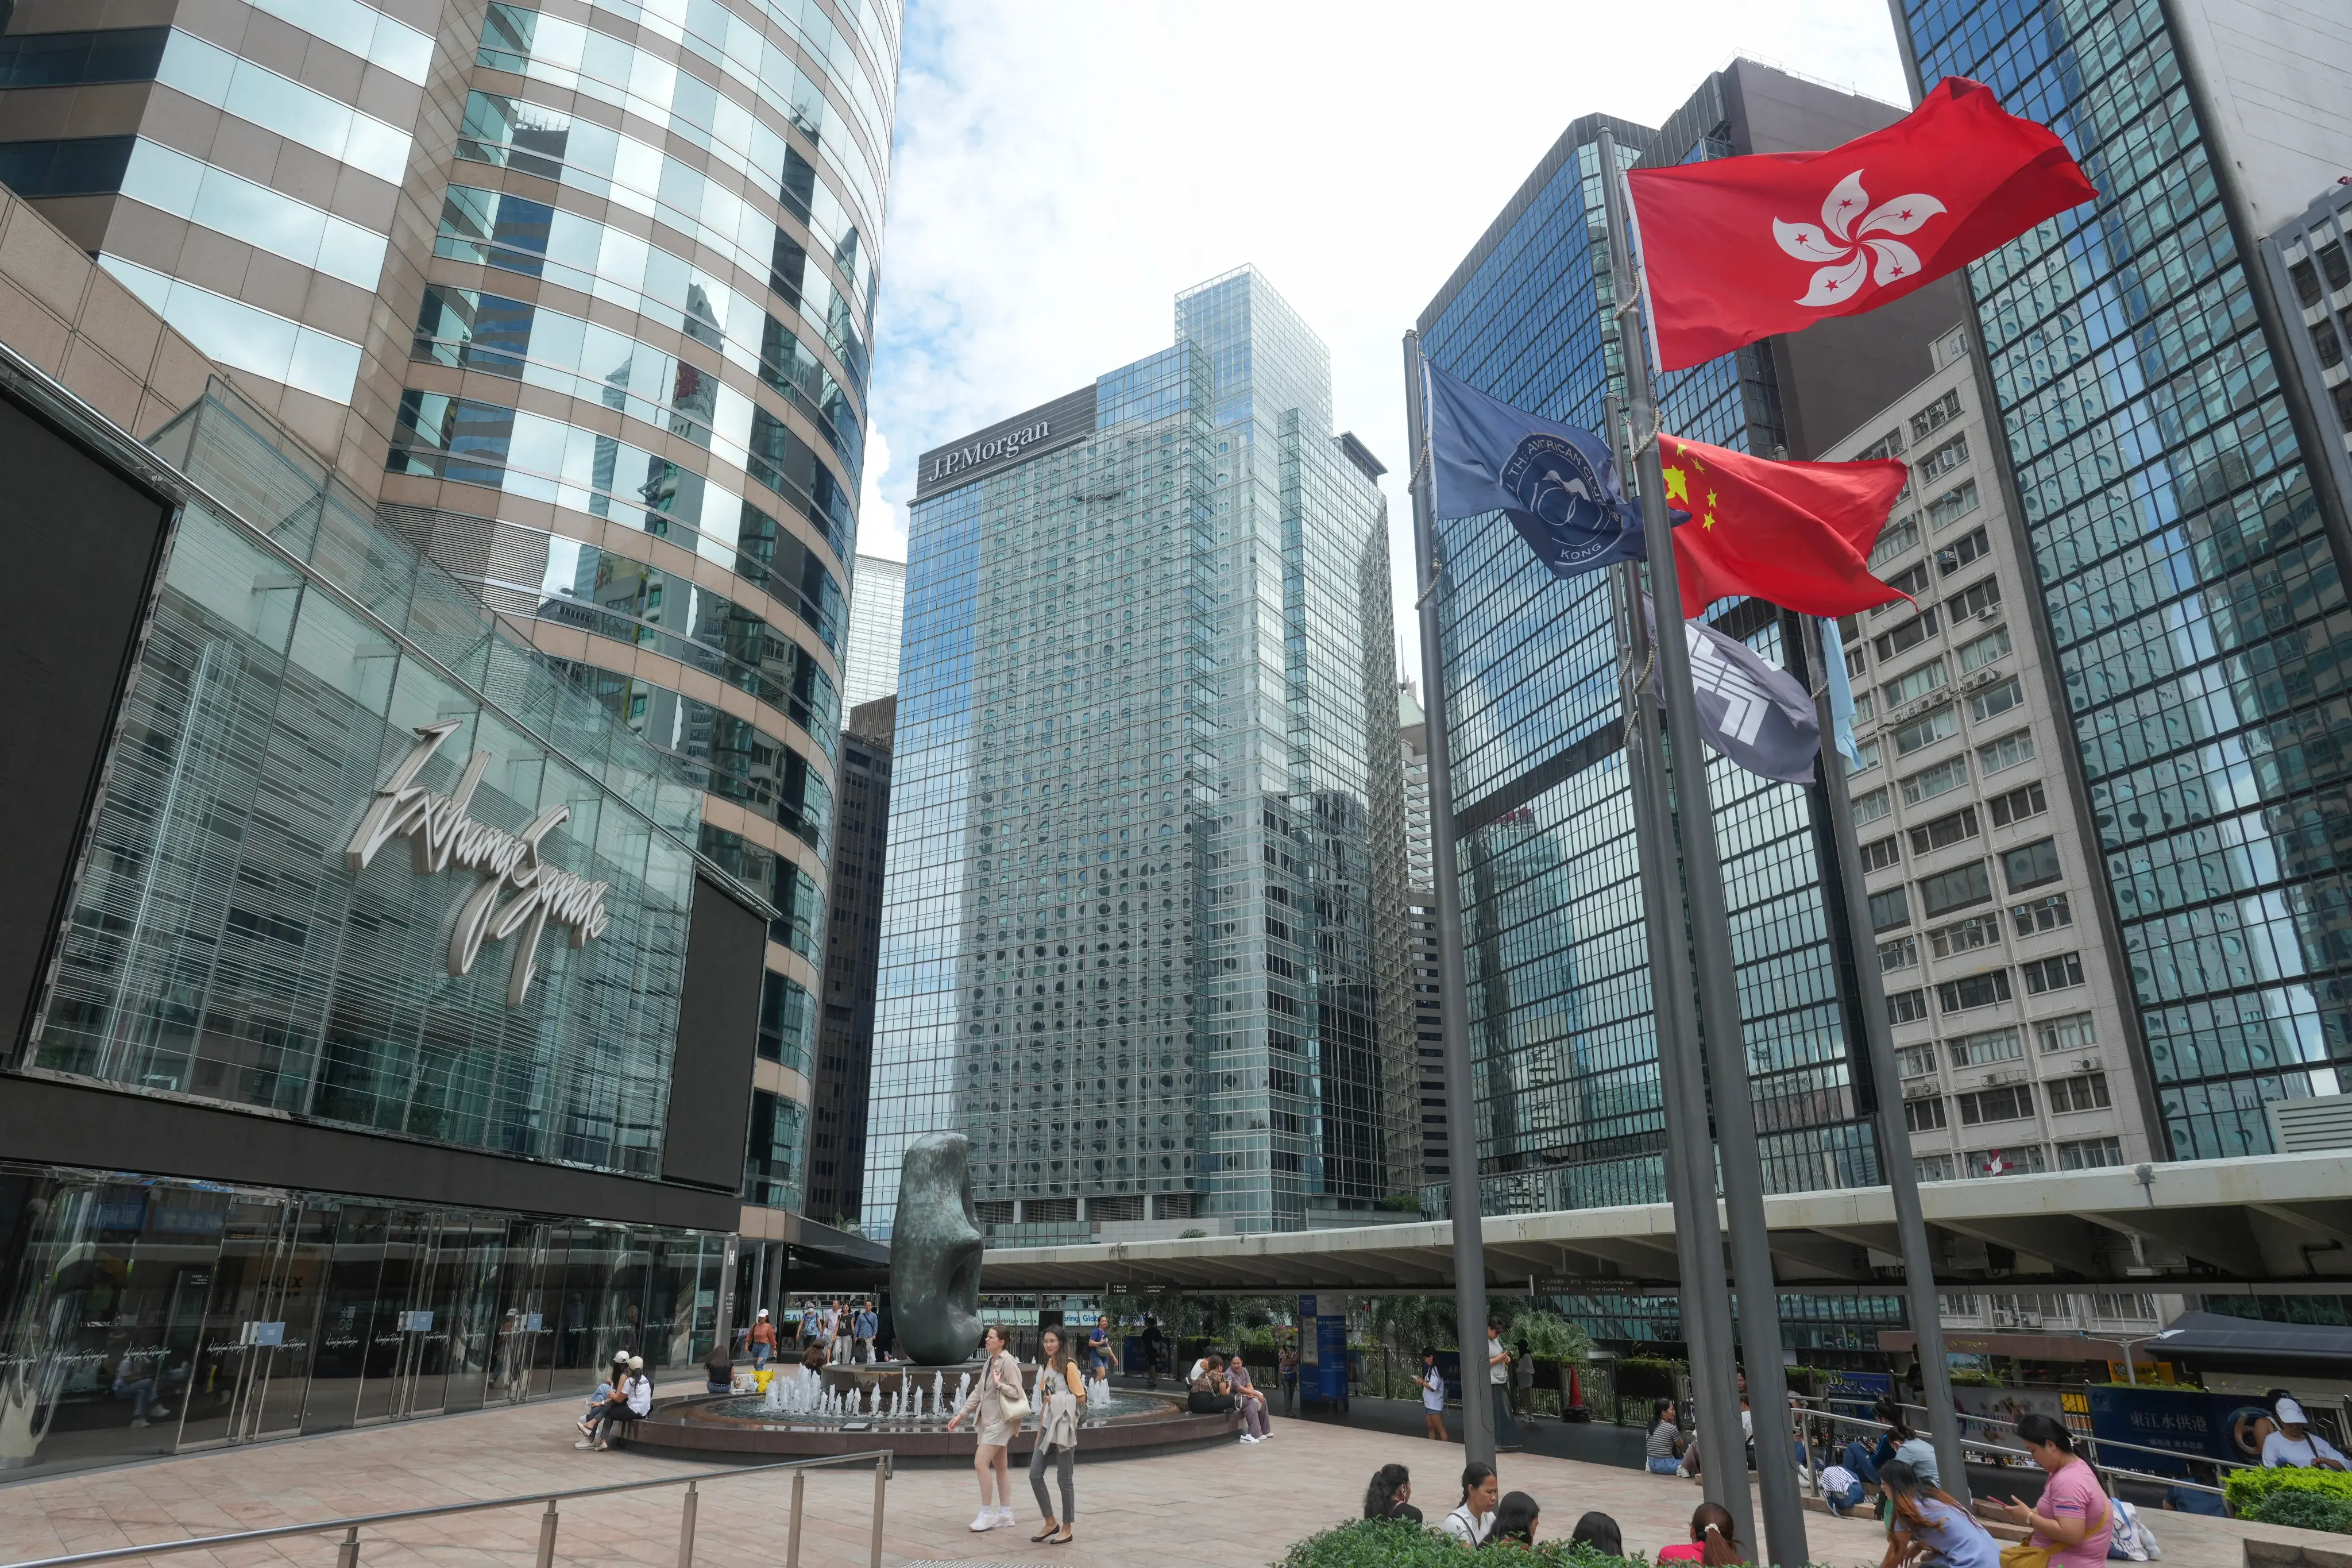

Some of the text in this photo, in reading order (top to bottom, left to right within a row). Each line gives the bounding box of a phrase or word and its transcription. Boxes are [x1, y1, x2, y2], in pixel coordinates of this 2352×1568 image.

[928, 420, 1049, 483] J.P.Morgan
[1560, 543, 1602, 561] KONG
[346, 719, 609, 1007] Exchange Square
[2130, 1410, 2208, 1432] 東江水供港
